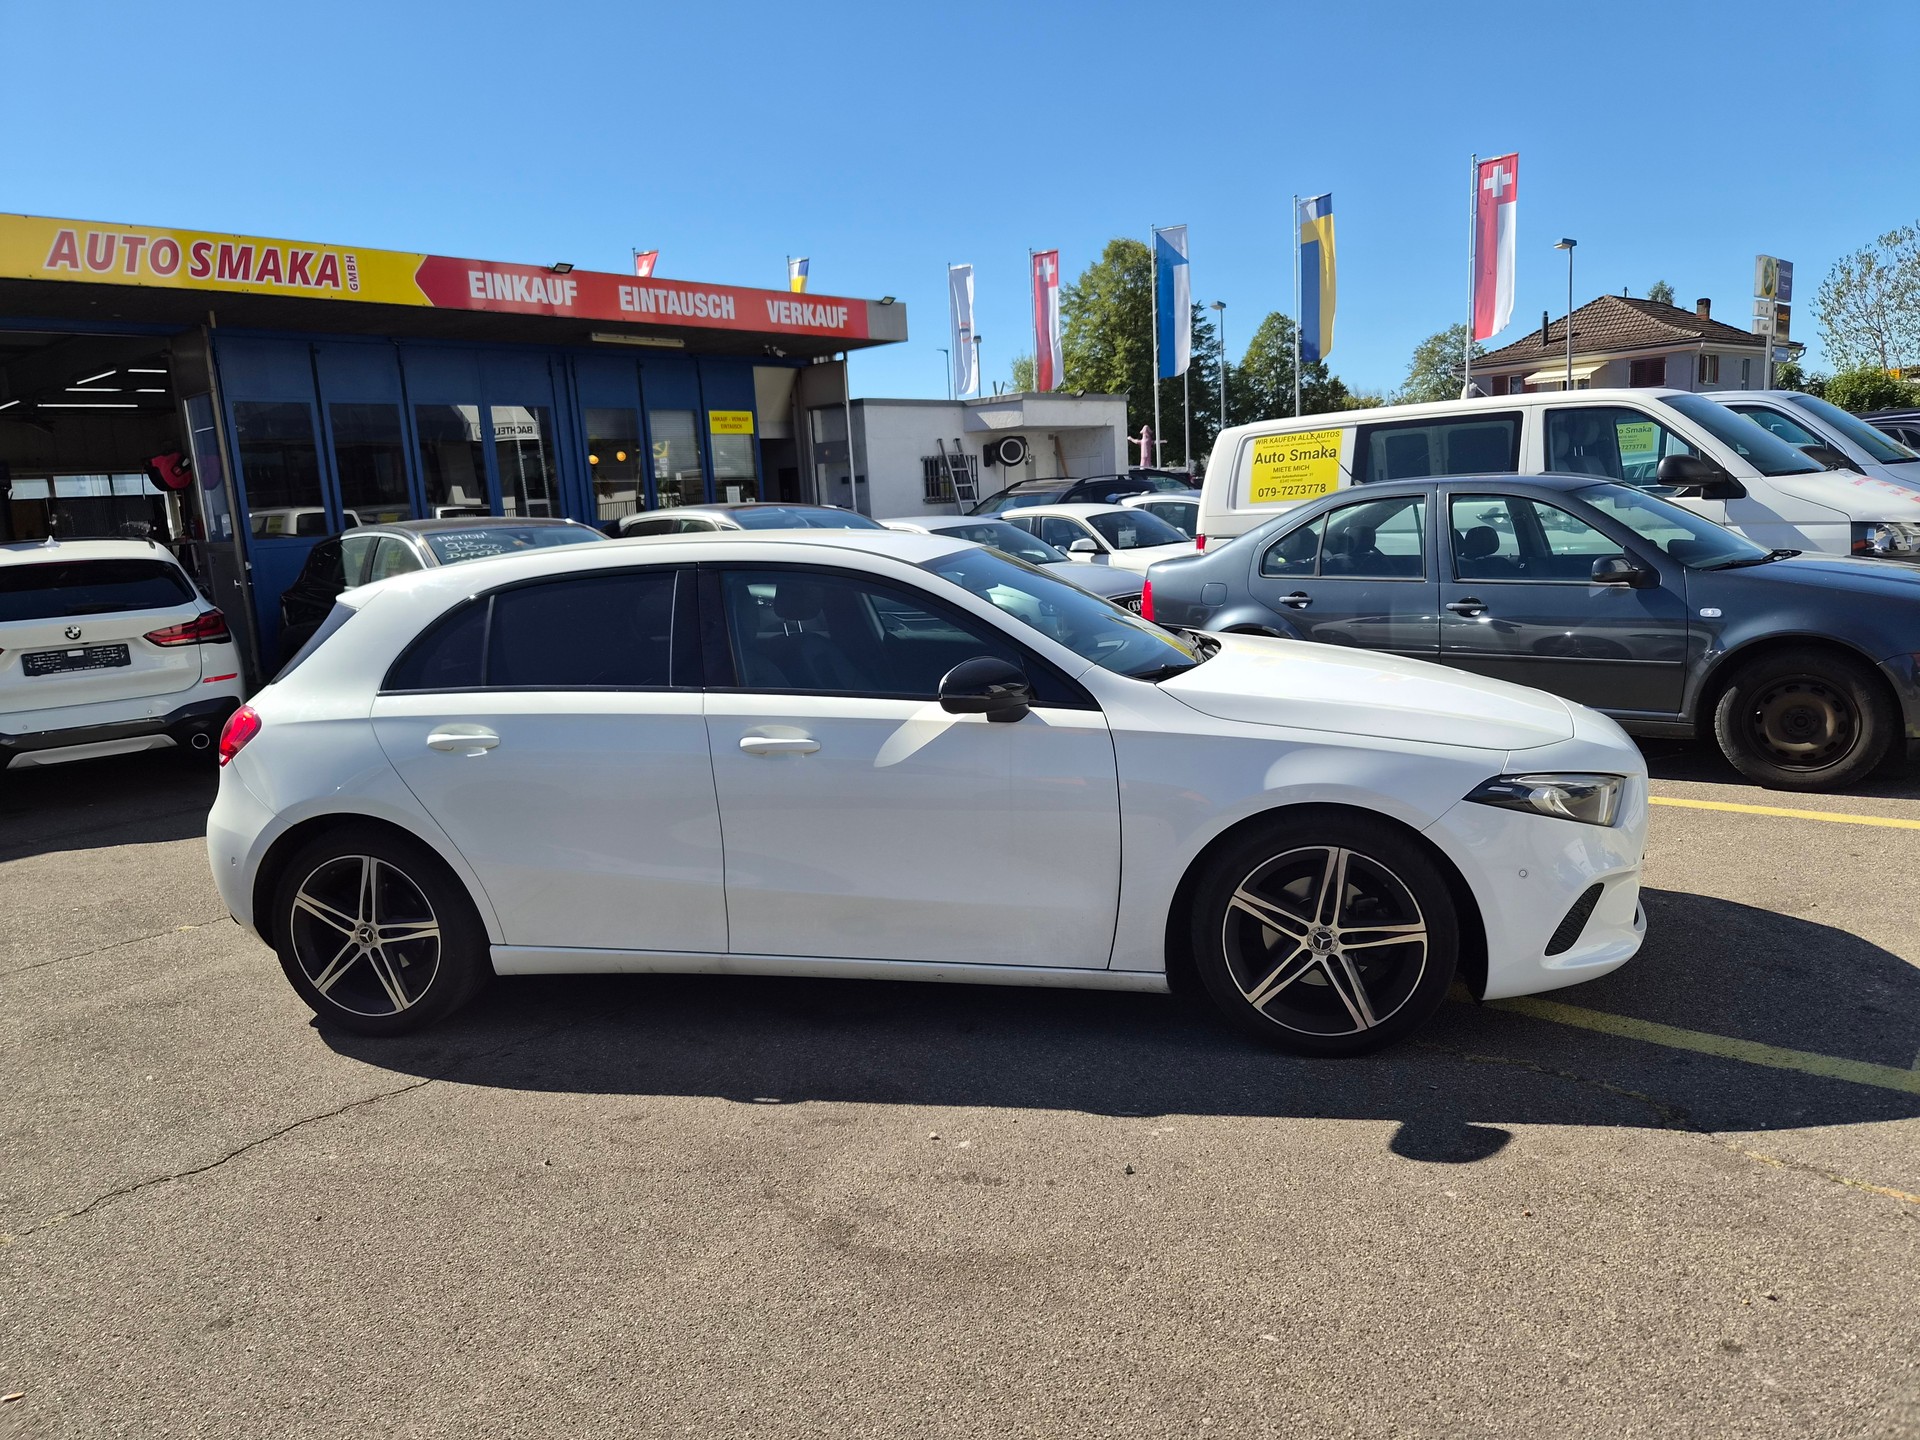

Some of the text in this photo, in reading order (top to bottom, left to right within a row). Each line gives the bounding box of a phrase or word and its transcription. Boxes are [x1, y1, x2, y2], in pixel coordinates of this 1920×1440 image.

[44, 230, 358, 291] AUTO SMAKA GMBH
[468, 271, 848, 329] EINKAUF EINTAUSCH VERKAUF
[1269, 435, 1296, 444] KAUFEN
[1298, 433, 1316, 441] ALLE
[1316, 430, 1340, 438] AUTOS
[1625, 426, 1652, 434] Smaka
[1254, 446, 1337, 465] Auto Smaka
[1258, 483, 1326, 497] 079-7273778
